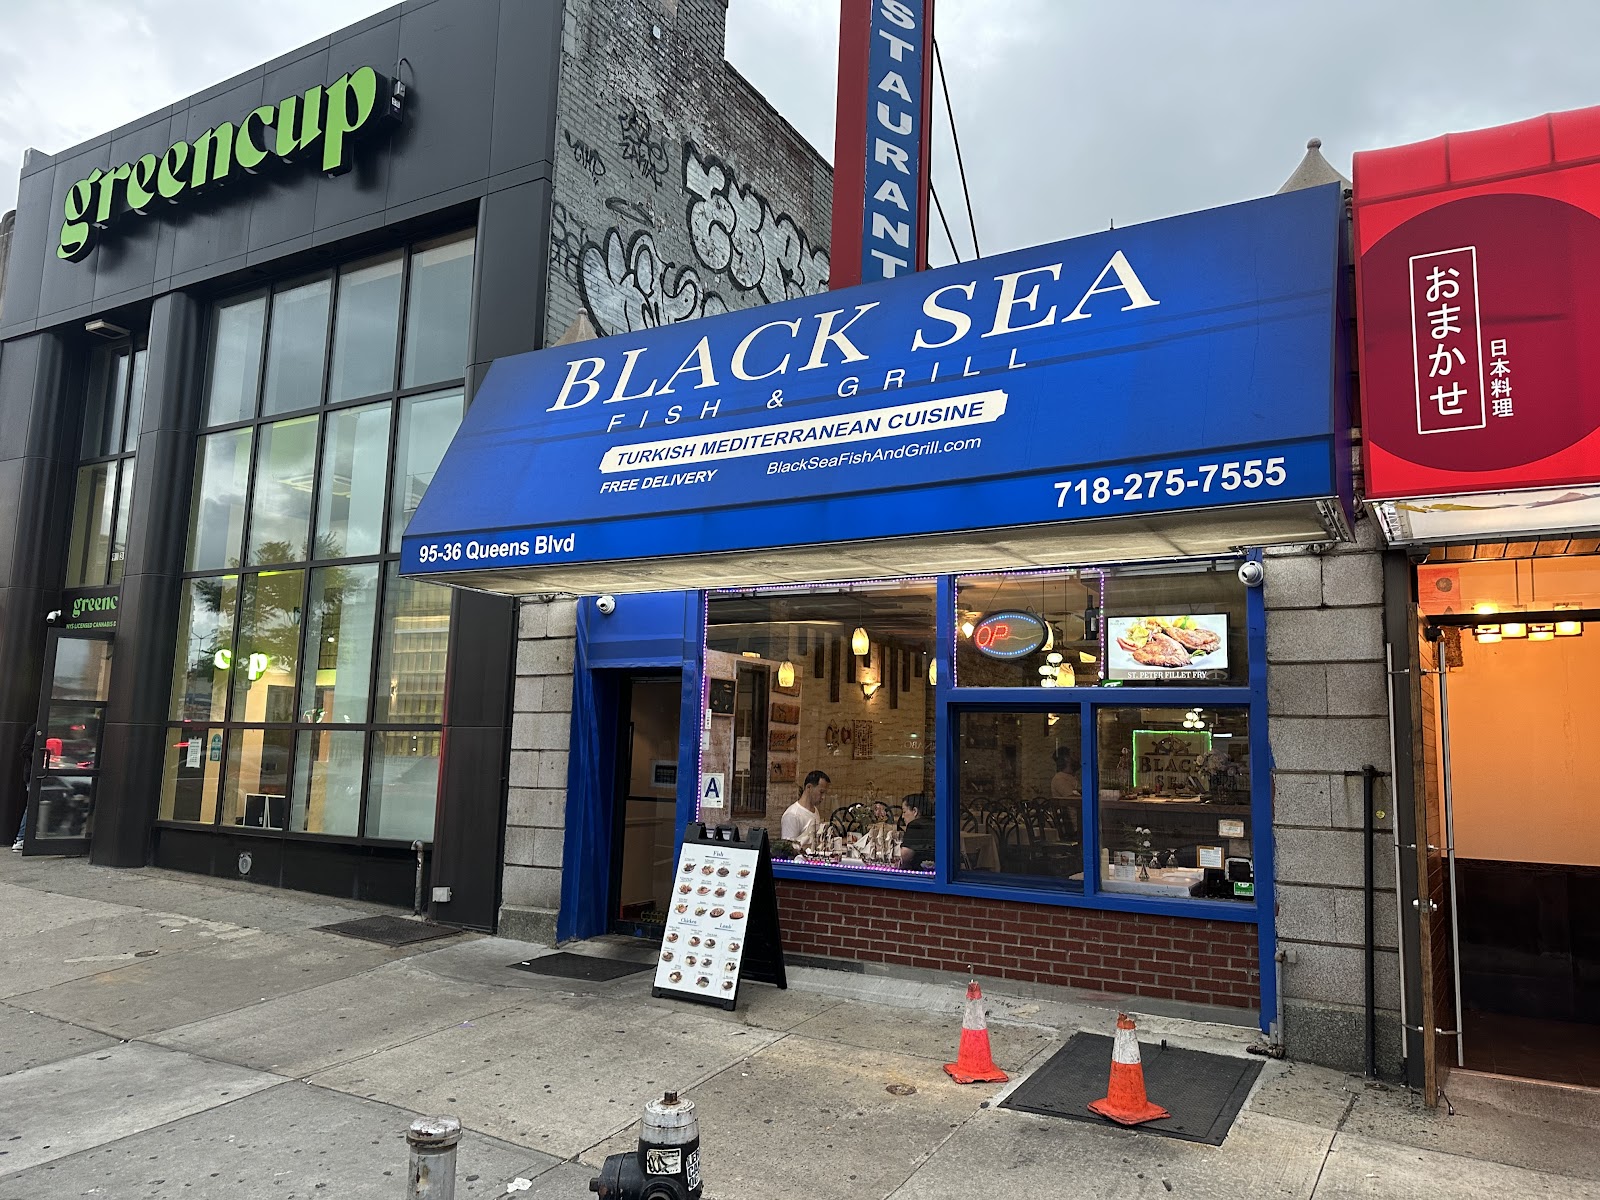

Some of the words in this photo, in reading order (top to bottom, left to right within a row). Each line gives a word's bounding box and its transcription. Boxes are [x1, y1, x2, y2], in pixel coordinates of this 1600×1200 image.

[56, 65, 377, 260] greencup
[545, 302, 881, 413] BLACK
[910, 249, 1161, 352] SEA
[1425, 265, 1468, 416] おまかせ
[606, 399, 722, 433] FISH
[766, 388, 784, 410] &
[837, 348, 1027, 398] GRILL
[1489, 338, 1514, 418] 日本料理
[616, 443, 697, 466] TURKISH
[700, 416, 882, 456] MEDITERRANEAN
[887, 400, 985, 430] CUISINE
[766, 436, 982, 476] BlackSeaFishAndGrill.com
[600, 478, 640, 494] FREE
[640, 468, 719, 490] DELIVERY
[1053, 456, 1287, 508] 718-275-7555
[419, 542, 462, 563] 95-36
[465, 540, 530, 561] Queens
[534, 532, 575, 555] Blvd
[1140, 671, 1163, 679] PETER
[1164, 671, 1191, 679] FILLET
[1191, 670, 1208, 679] FRY
[704, 777, 720, 798] A
[1138, 755, 1199, 774] BLAC
